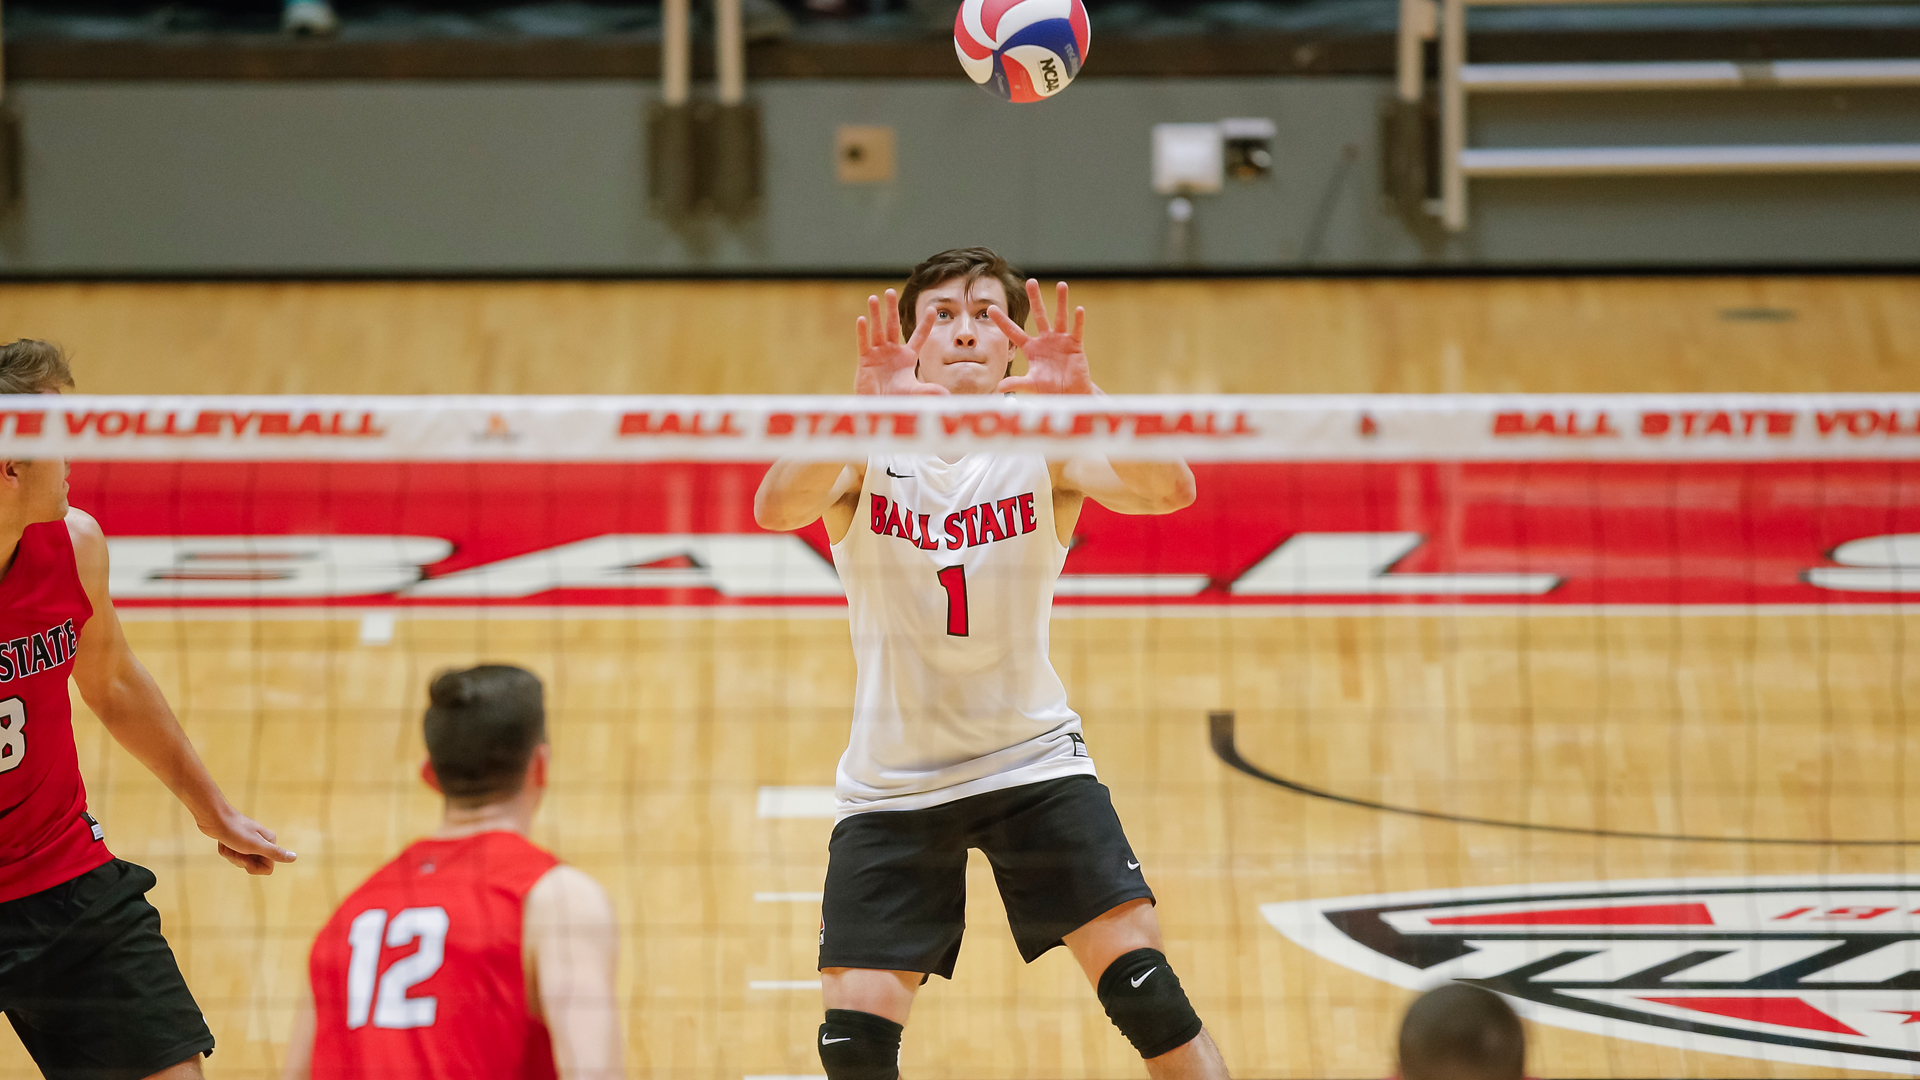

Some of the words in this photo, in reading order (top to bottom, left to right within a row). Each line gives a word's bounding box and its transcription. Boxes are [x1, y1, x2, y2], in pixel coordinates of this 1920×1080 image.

[1040, 57, 1060, 93] NCAA
[64, 409, 386, 438] VOLLEYBALL
[617, 410, 744, 438] BALL
[764, 410, 920, 438] STATE
[938, 410, 1259, 438] VOLLEYBALL
[1491, 410, 1619, 438] BALL
[1640, 410, 1795, 438] STATE
[870, 492, 940, 551] BALL
[944, 491, 1037, 551] STATE
[936, 564, 969, 637] 1
[0, 617, 78, 683] STATE
[346, 906, 450, 1030] 12
